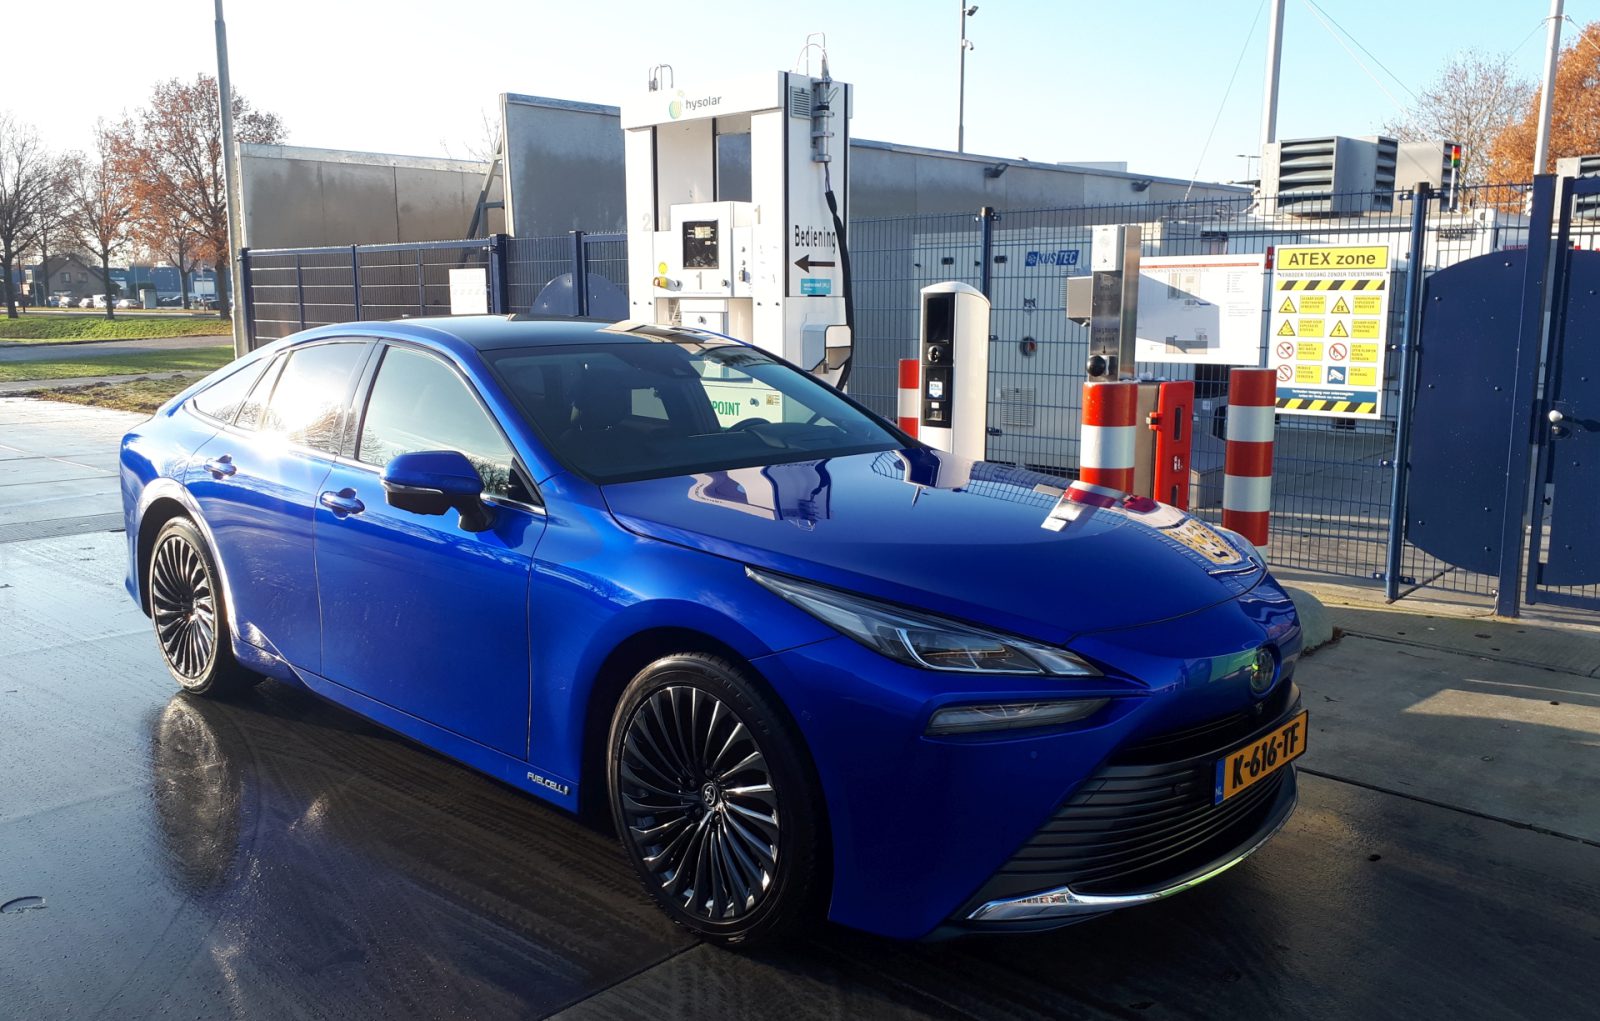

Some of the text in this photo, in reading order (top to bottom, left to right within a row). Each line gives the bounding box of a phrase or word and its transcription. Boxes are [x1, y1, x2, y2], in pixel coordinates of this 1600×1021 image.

[685, 96, 722, 110] hysolar
[795, 225, 836, 254] Bediening
[1288, 252, 1376, 266] ATEX zone
[712, 400, 740, 416] POINT
[1232, 722, 1300, 790] K-616-TF
